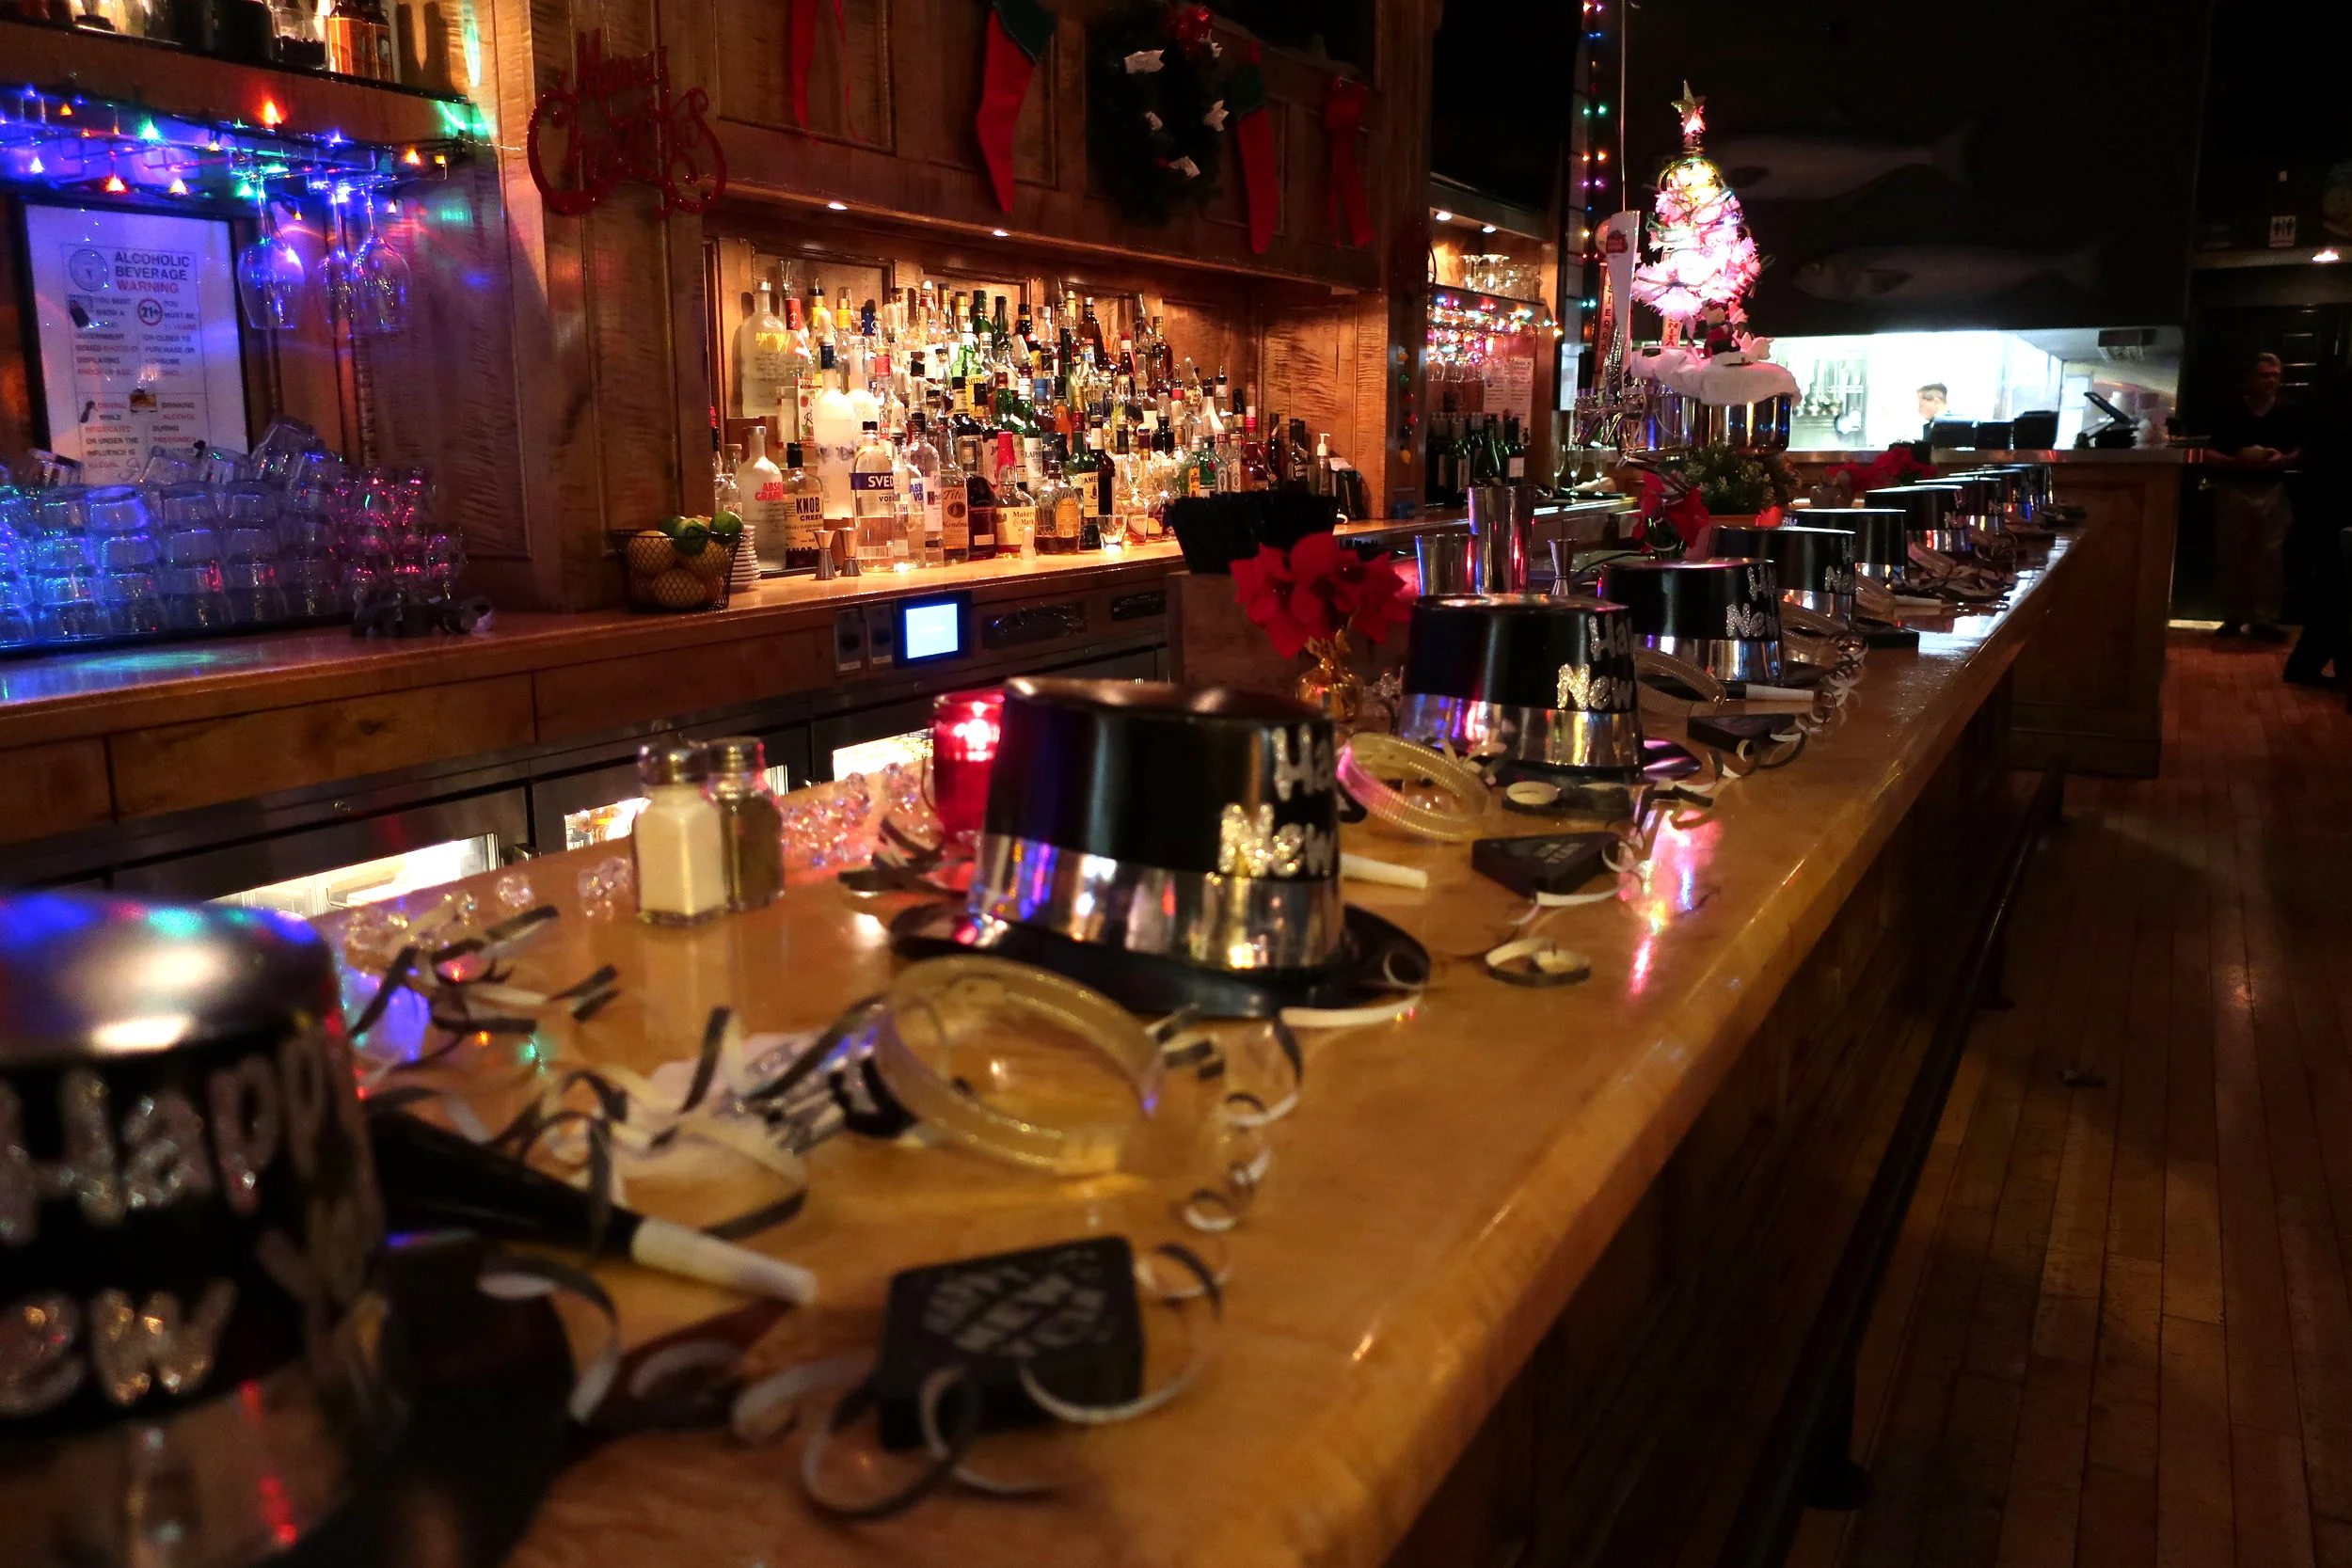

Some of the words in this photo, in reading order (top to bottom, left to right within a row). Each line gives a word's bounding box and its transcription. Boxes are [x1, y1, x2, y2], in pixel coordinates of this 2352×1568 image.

[115, 251, 190, 268] ALCOHOLIC
[115, 265, 188, 280] BEVERAGE
[117, 279, 181, 294] WARNING
[796, 496, 820, 515] KNOB
[1557, 663, 1634, 712] New
[1217, 800, 1335, 879] New
